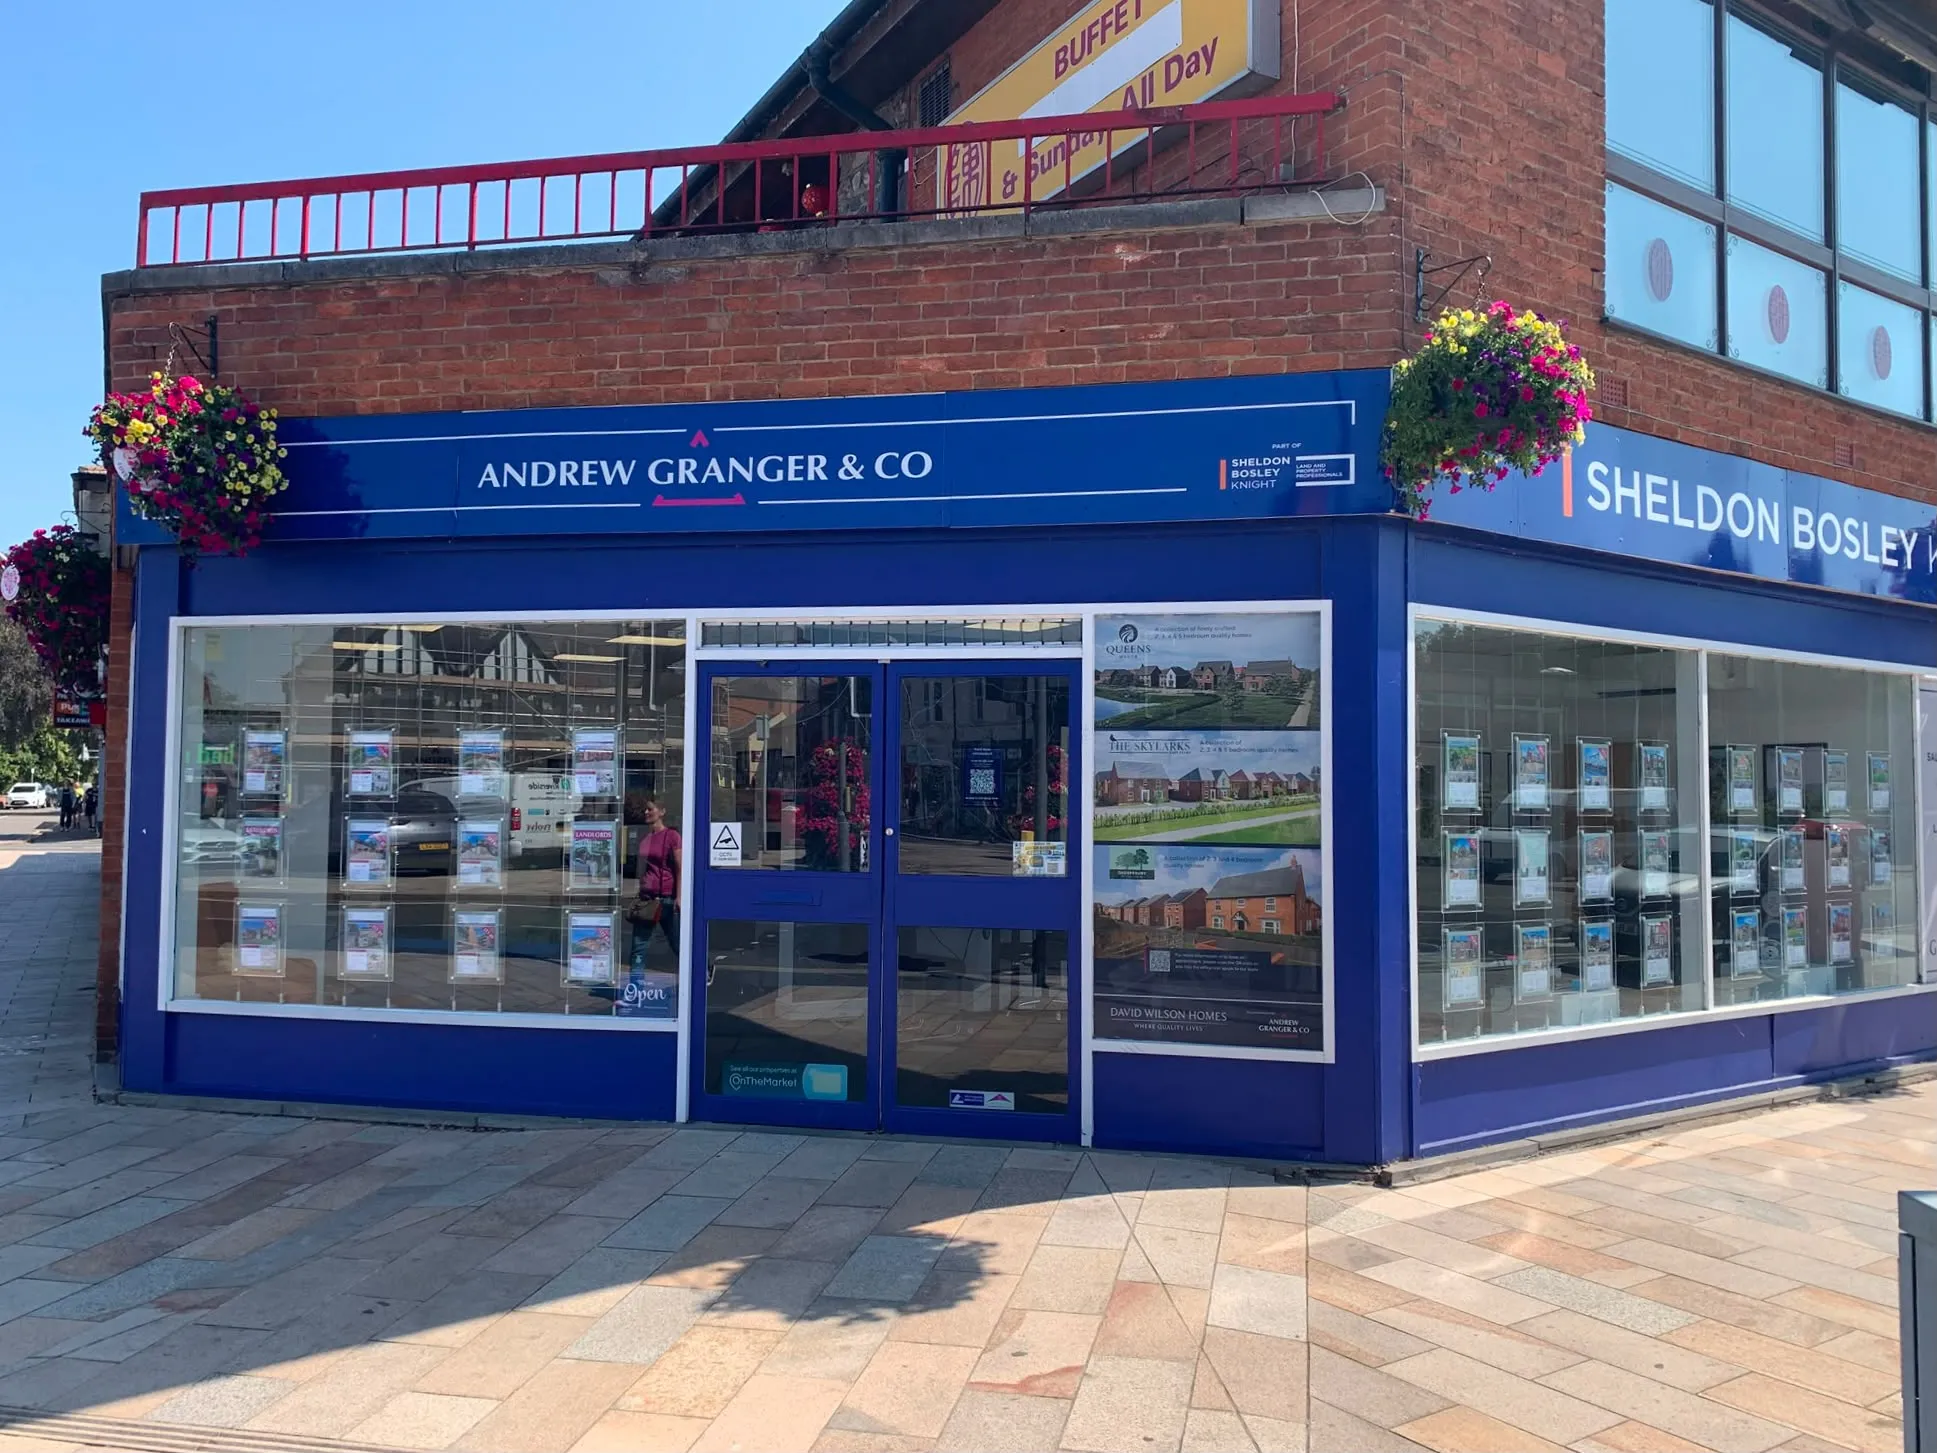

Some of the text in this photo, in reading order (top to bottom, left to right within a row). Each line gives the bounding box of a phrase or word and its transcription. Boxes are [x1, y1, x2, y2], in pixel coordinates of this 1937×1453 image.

[1054, 0, 1142, 80] BUFFET
[1122, 36, 1219, 110] All Day
[1231, 456, 1291, 467] SHELDON
[477, 450, 933, 489] ANDREW GRANGER & CO
[1231, 468, 1281, 478] BOSLEY
[1231, 479, 1277, 490] KNIGHT
[1587, 461, 1780, 545] SHELDON
[1793, 505, 1918, 570] BOSLEY
[1106, 644, 1151, 655] QUEENS
[1109, 740, 1191, 752] THE SKYLARKS
[624, 983, 666, 1008] Open
[1110, 1007, 1228, 1022] DAVID WILSON HOMES
[1258, 1025, 1291, 1033] GRANGER
[730, 1073, 797, 1091] OnTheMarket
